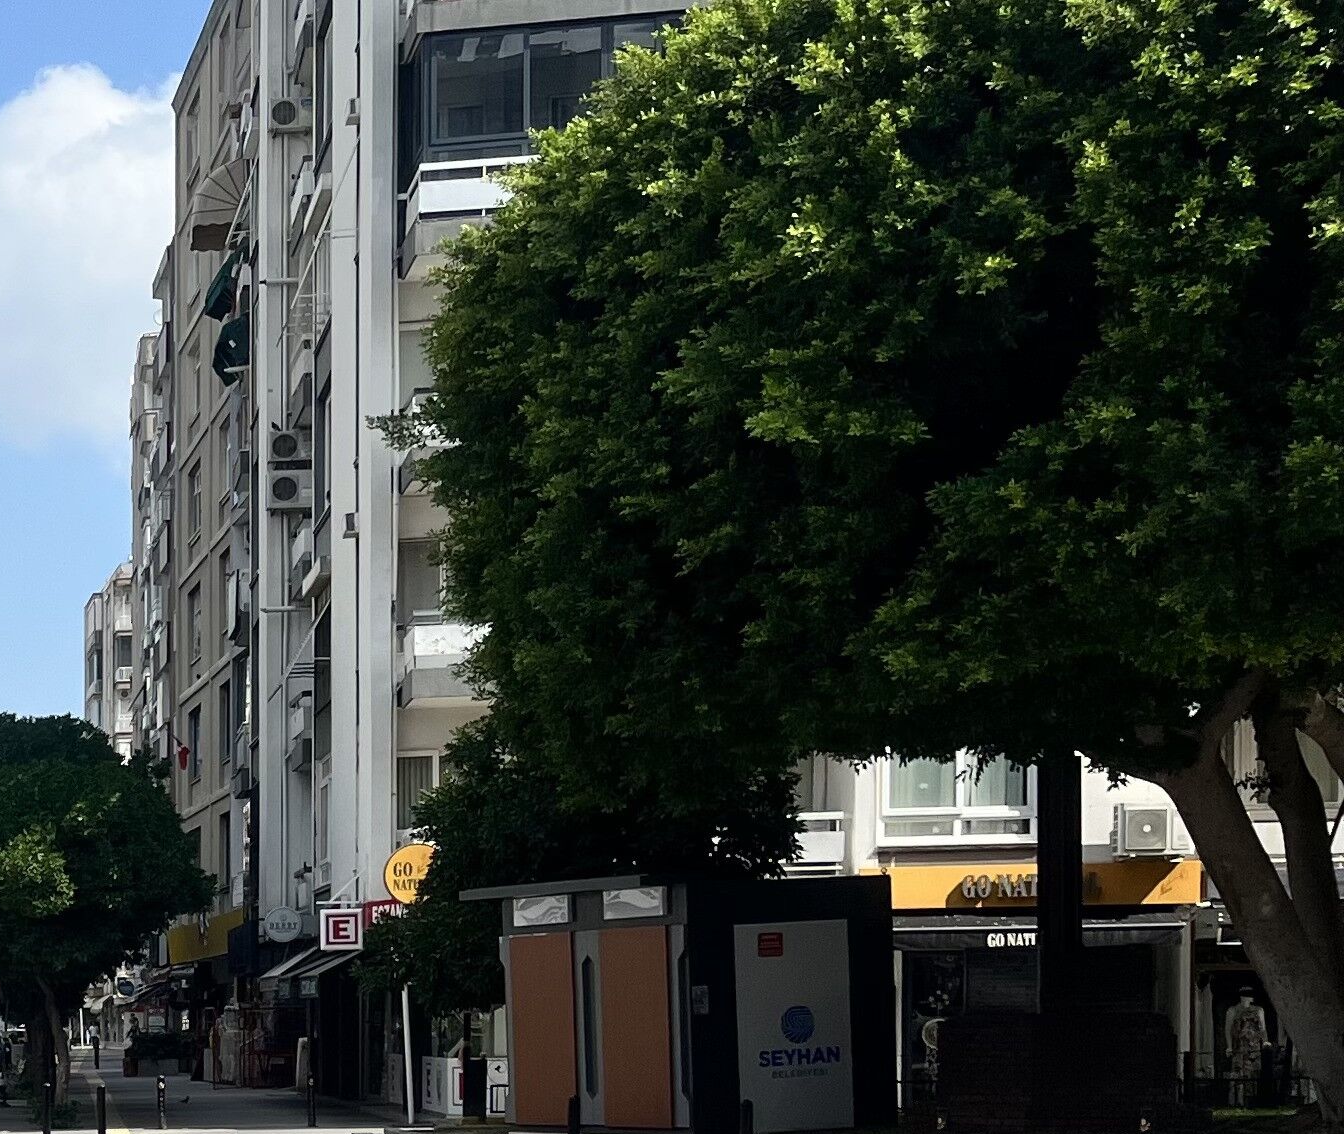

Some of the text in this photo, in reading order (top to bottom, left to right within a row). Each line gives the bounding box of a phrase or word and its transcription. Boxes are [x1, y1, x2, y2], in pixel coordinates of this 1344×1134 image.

[393, 861, 413, 877] GO
[962, 874, 993, 898] GO
[332, 919, 351, 939] E
[987, 933, 1005, 947] GO
[759, 1045, 842, 1068] SEYHAN
